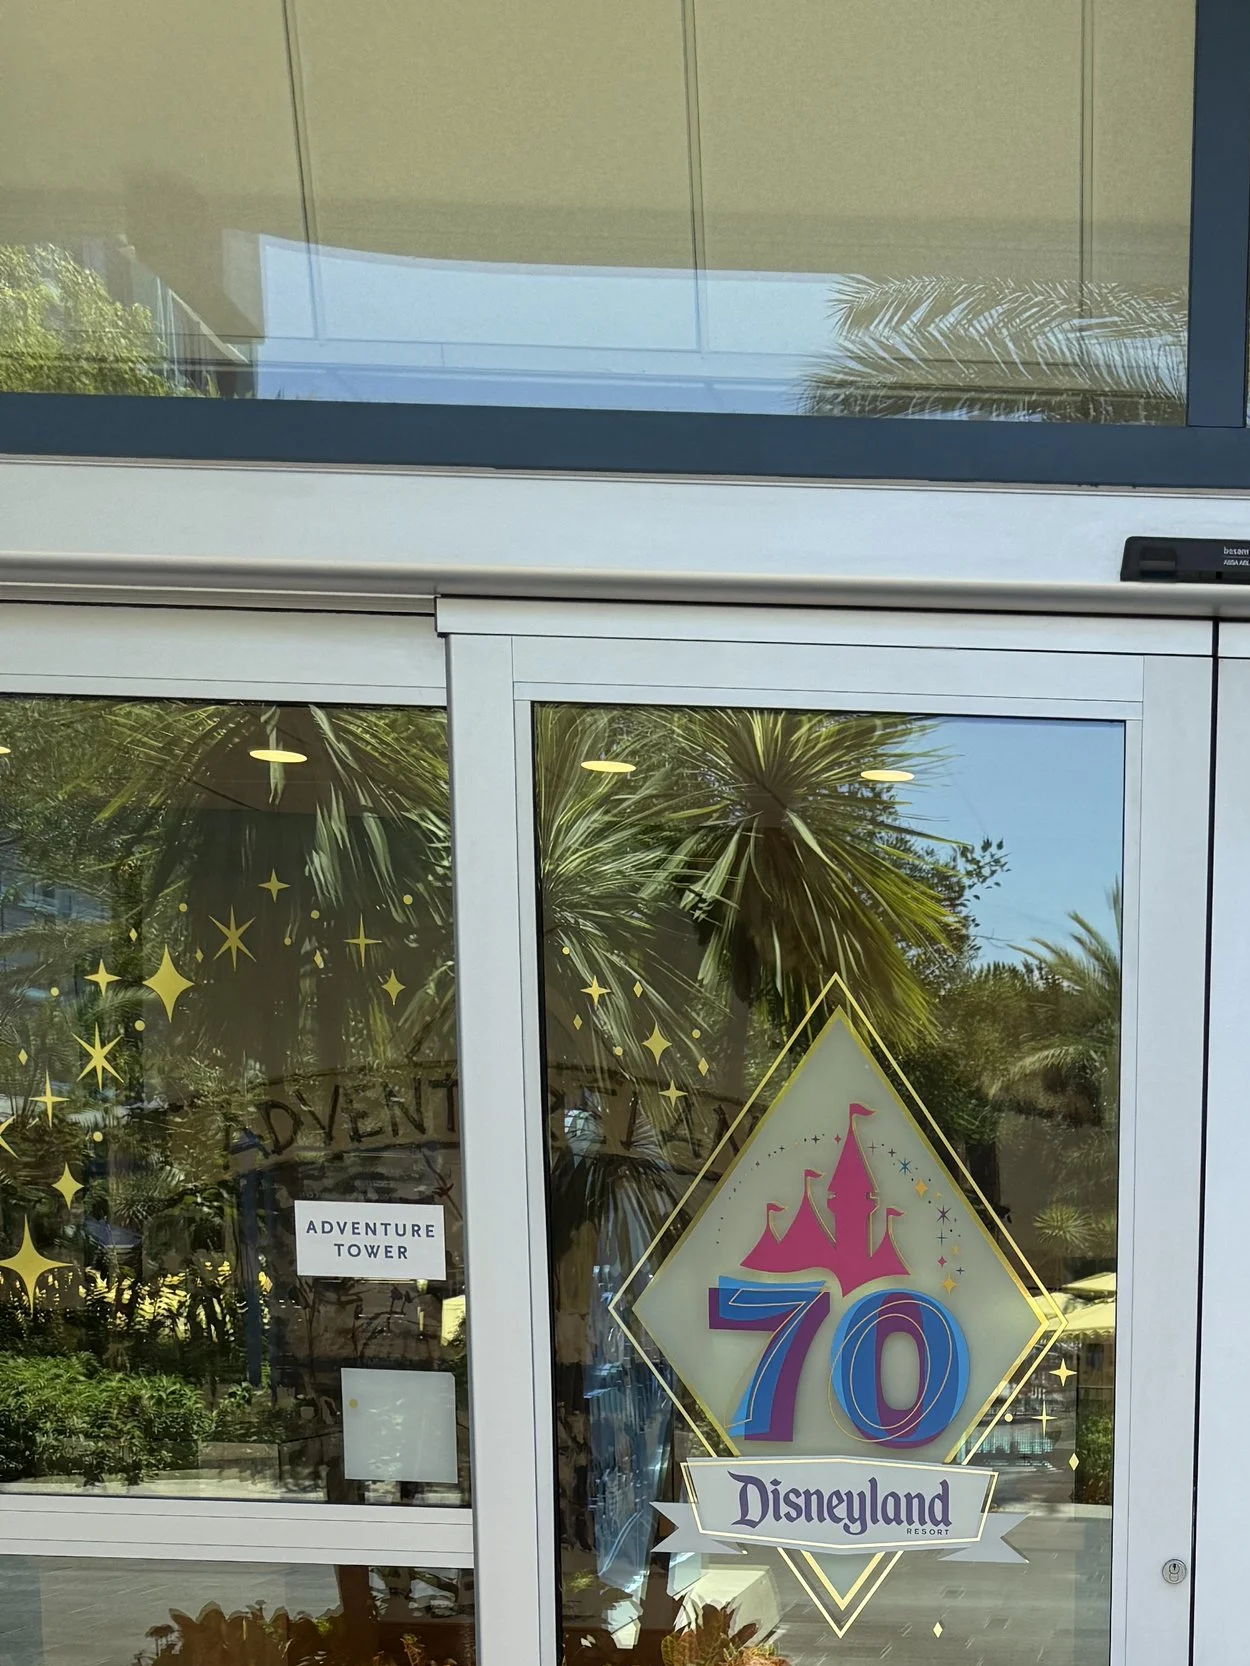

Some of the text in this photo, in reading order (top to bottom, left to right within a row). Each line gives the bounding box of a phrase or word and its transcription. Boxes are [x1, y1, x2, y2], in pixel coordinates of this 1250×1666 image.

[306, 1219, 436, 1238] ADVENTURE
[334, 1243, 409, 1260] TOWER
[708, 1275, 971, 1450] 70
[726, 1470, 953, 1536] Disneyland
[906, 1527, 950, 1536] RESORT
